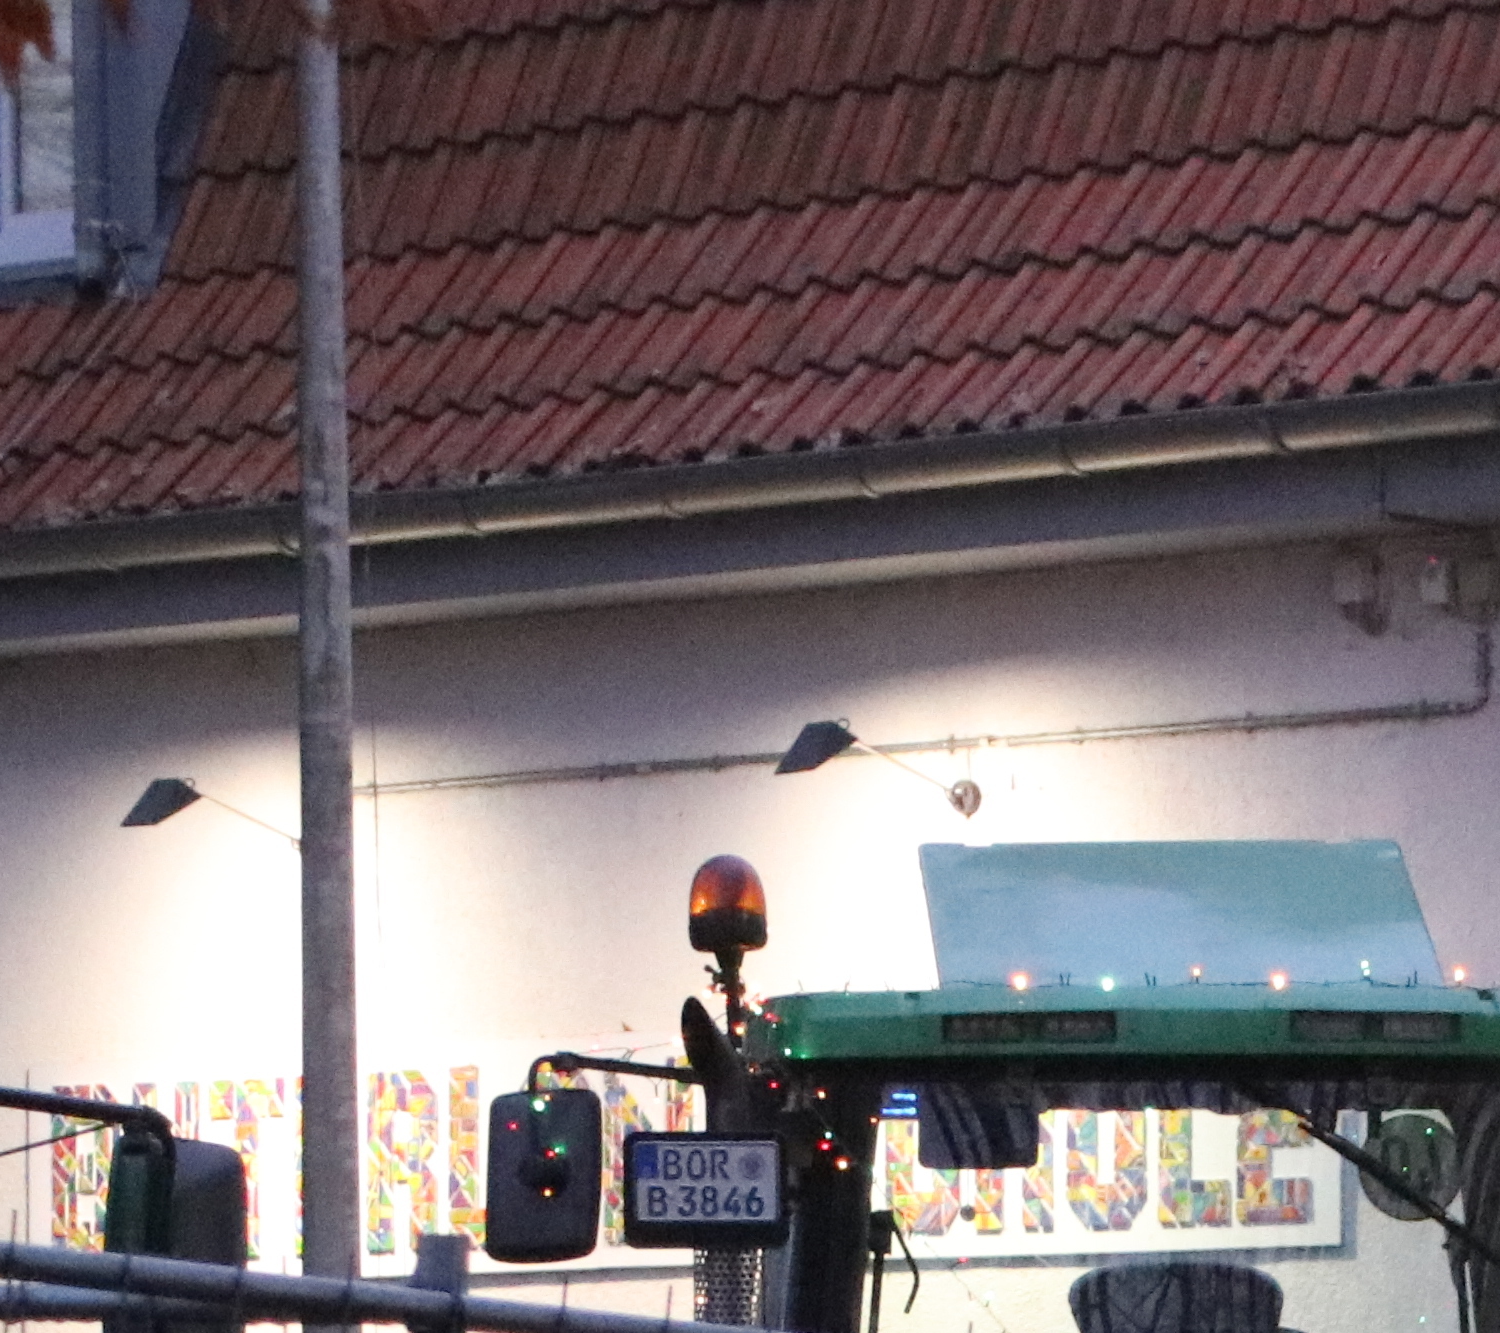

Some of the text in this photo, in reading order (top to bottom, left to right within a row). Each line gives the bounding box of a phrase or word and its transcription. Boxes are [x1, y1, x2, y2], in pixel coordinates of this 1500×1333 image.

[663, 1149, 729, 1180] BOR
[648, 1186, 764, 1217] B 3846
